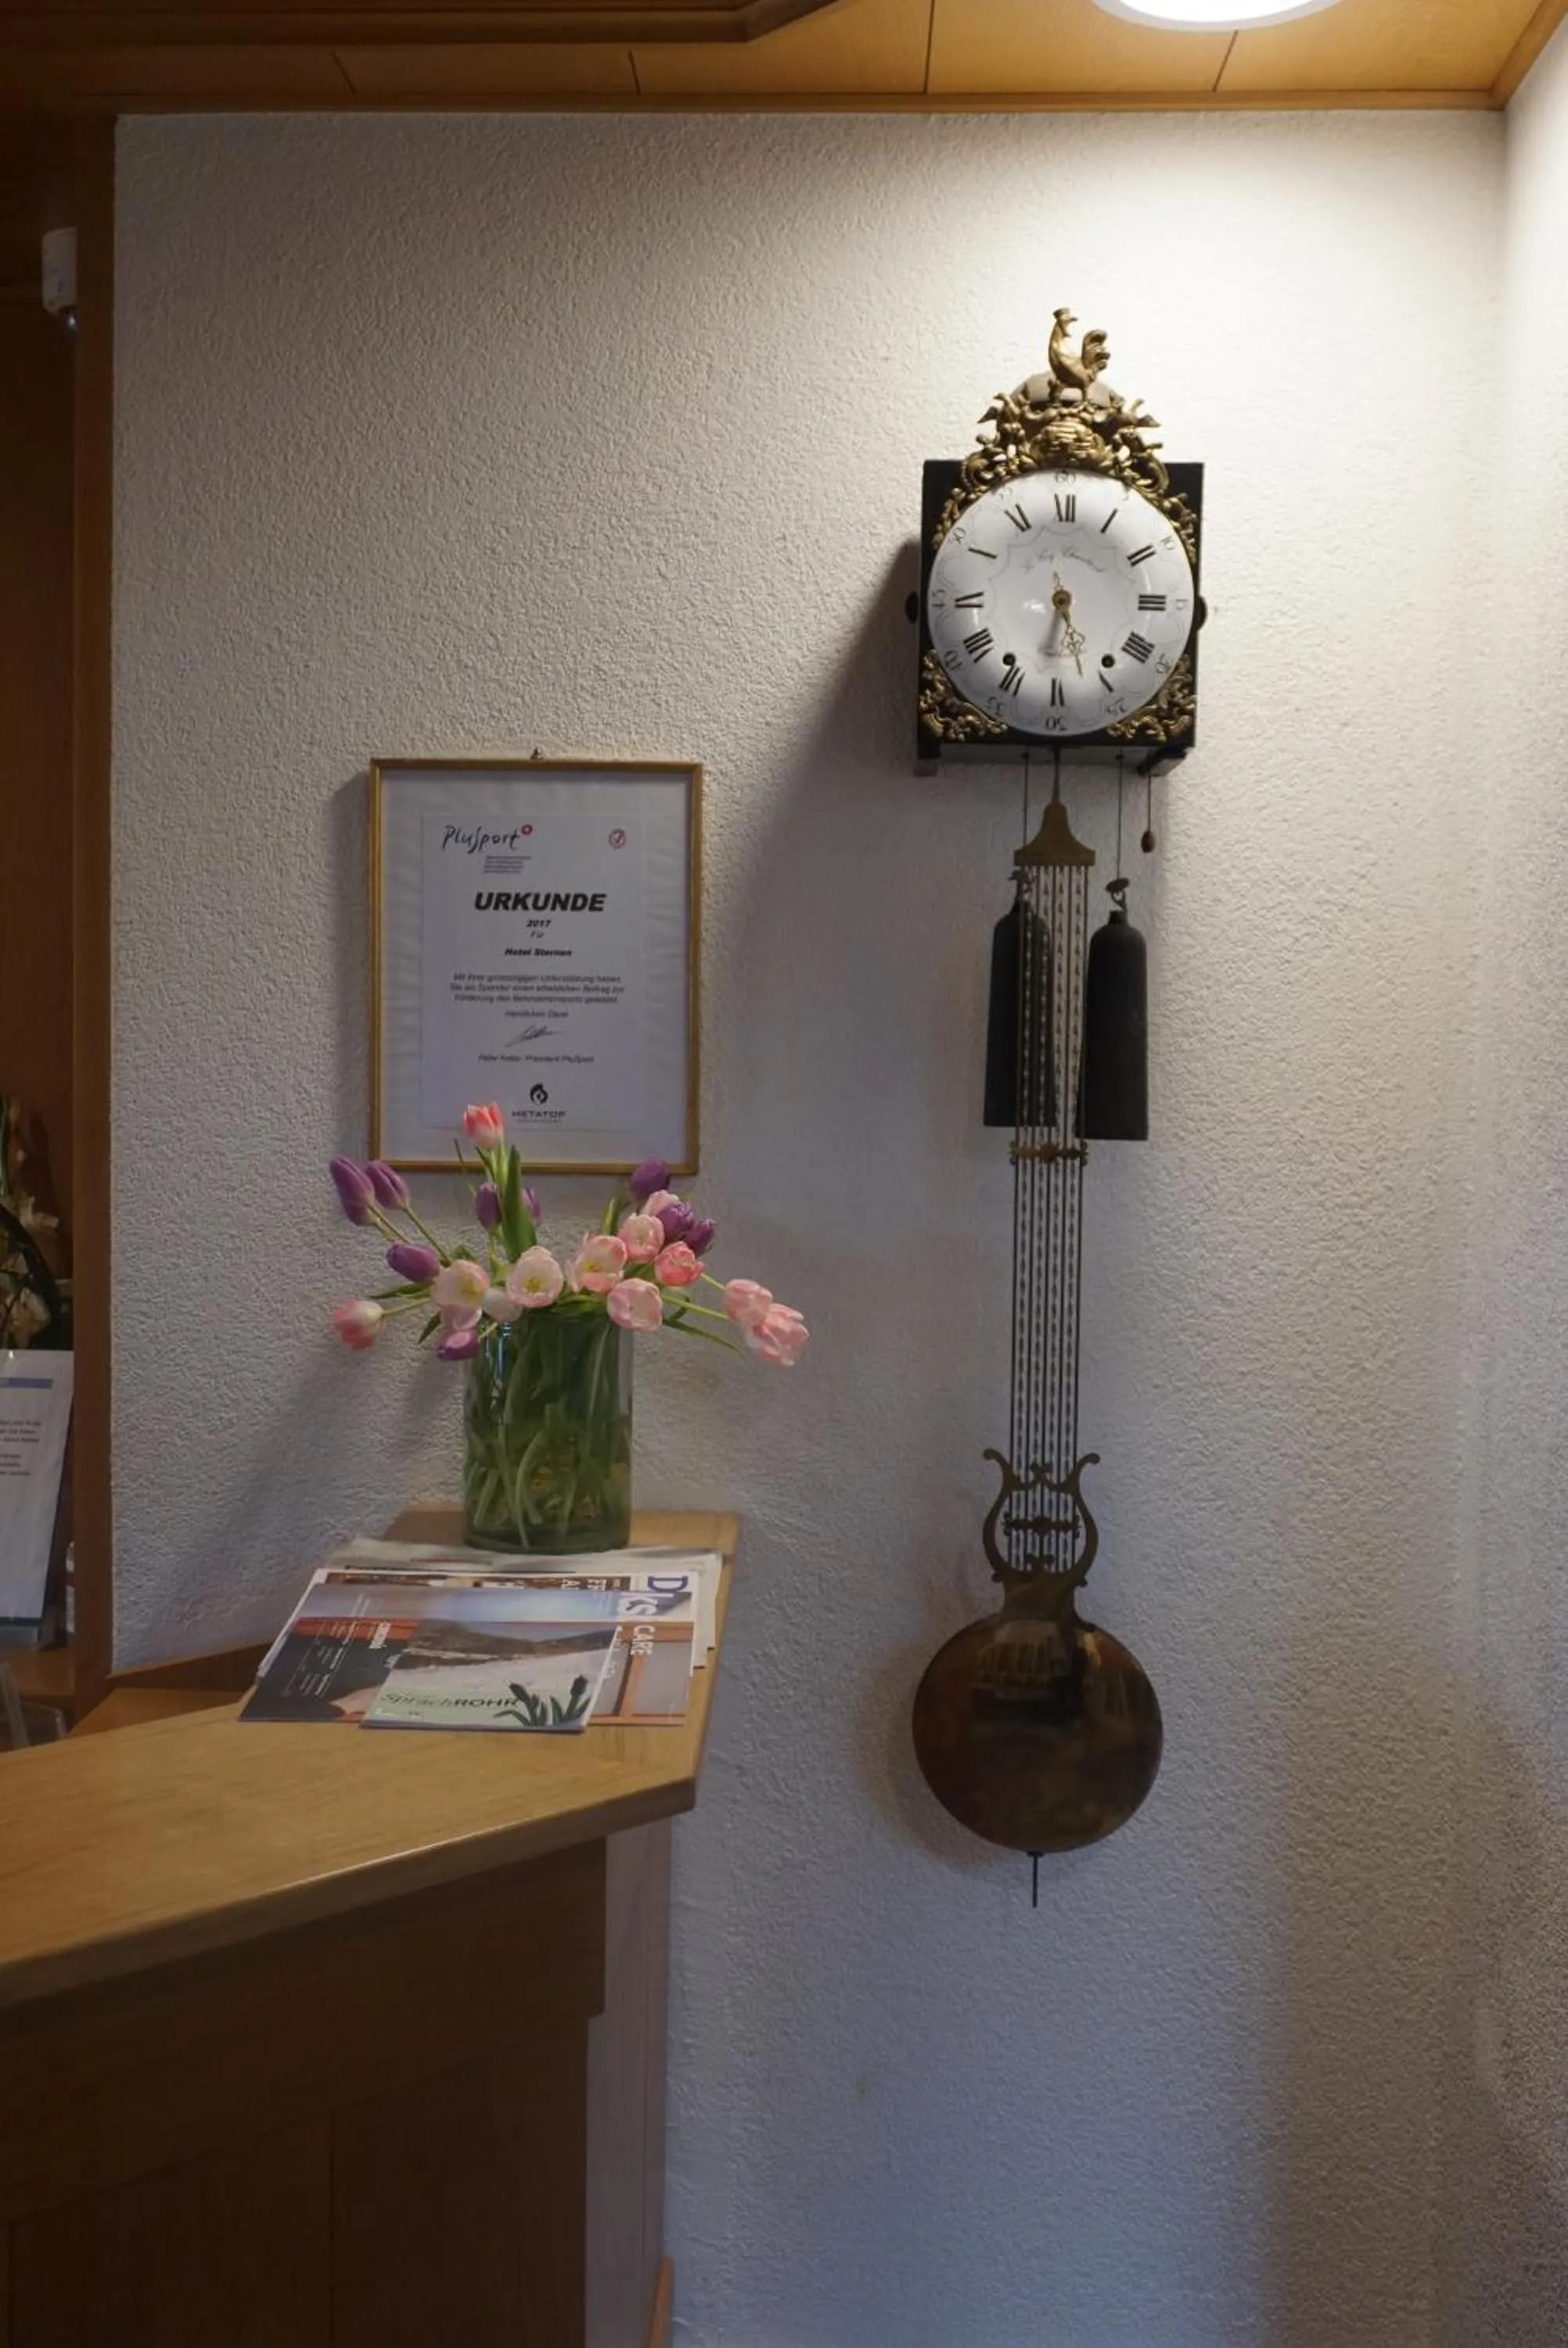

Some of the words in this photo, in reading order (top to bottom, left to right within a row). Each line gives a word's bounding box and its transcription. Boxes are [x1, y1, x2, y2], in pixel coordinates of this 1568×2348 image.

[474, 891, 607, 912] URKUNDE
[526, 919, 552, 928] 2017
[505, 947, 531, 956] Hotel
[534, 948, 573, 956] Sternen
